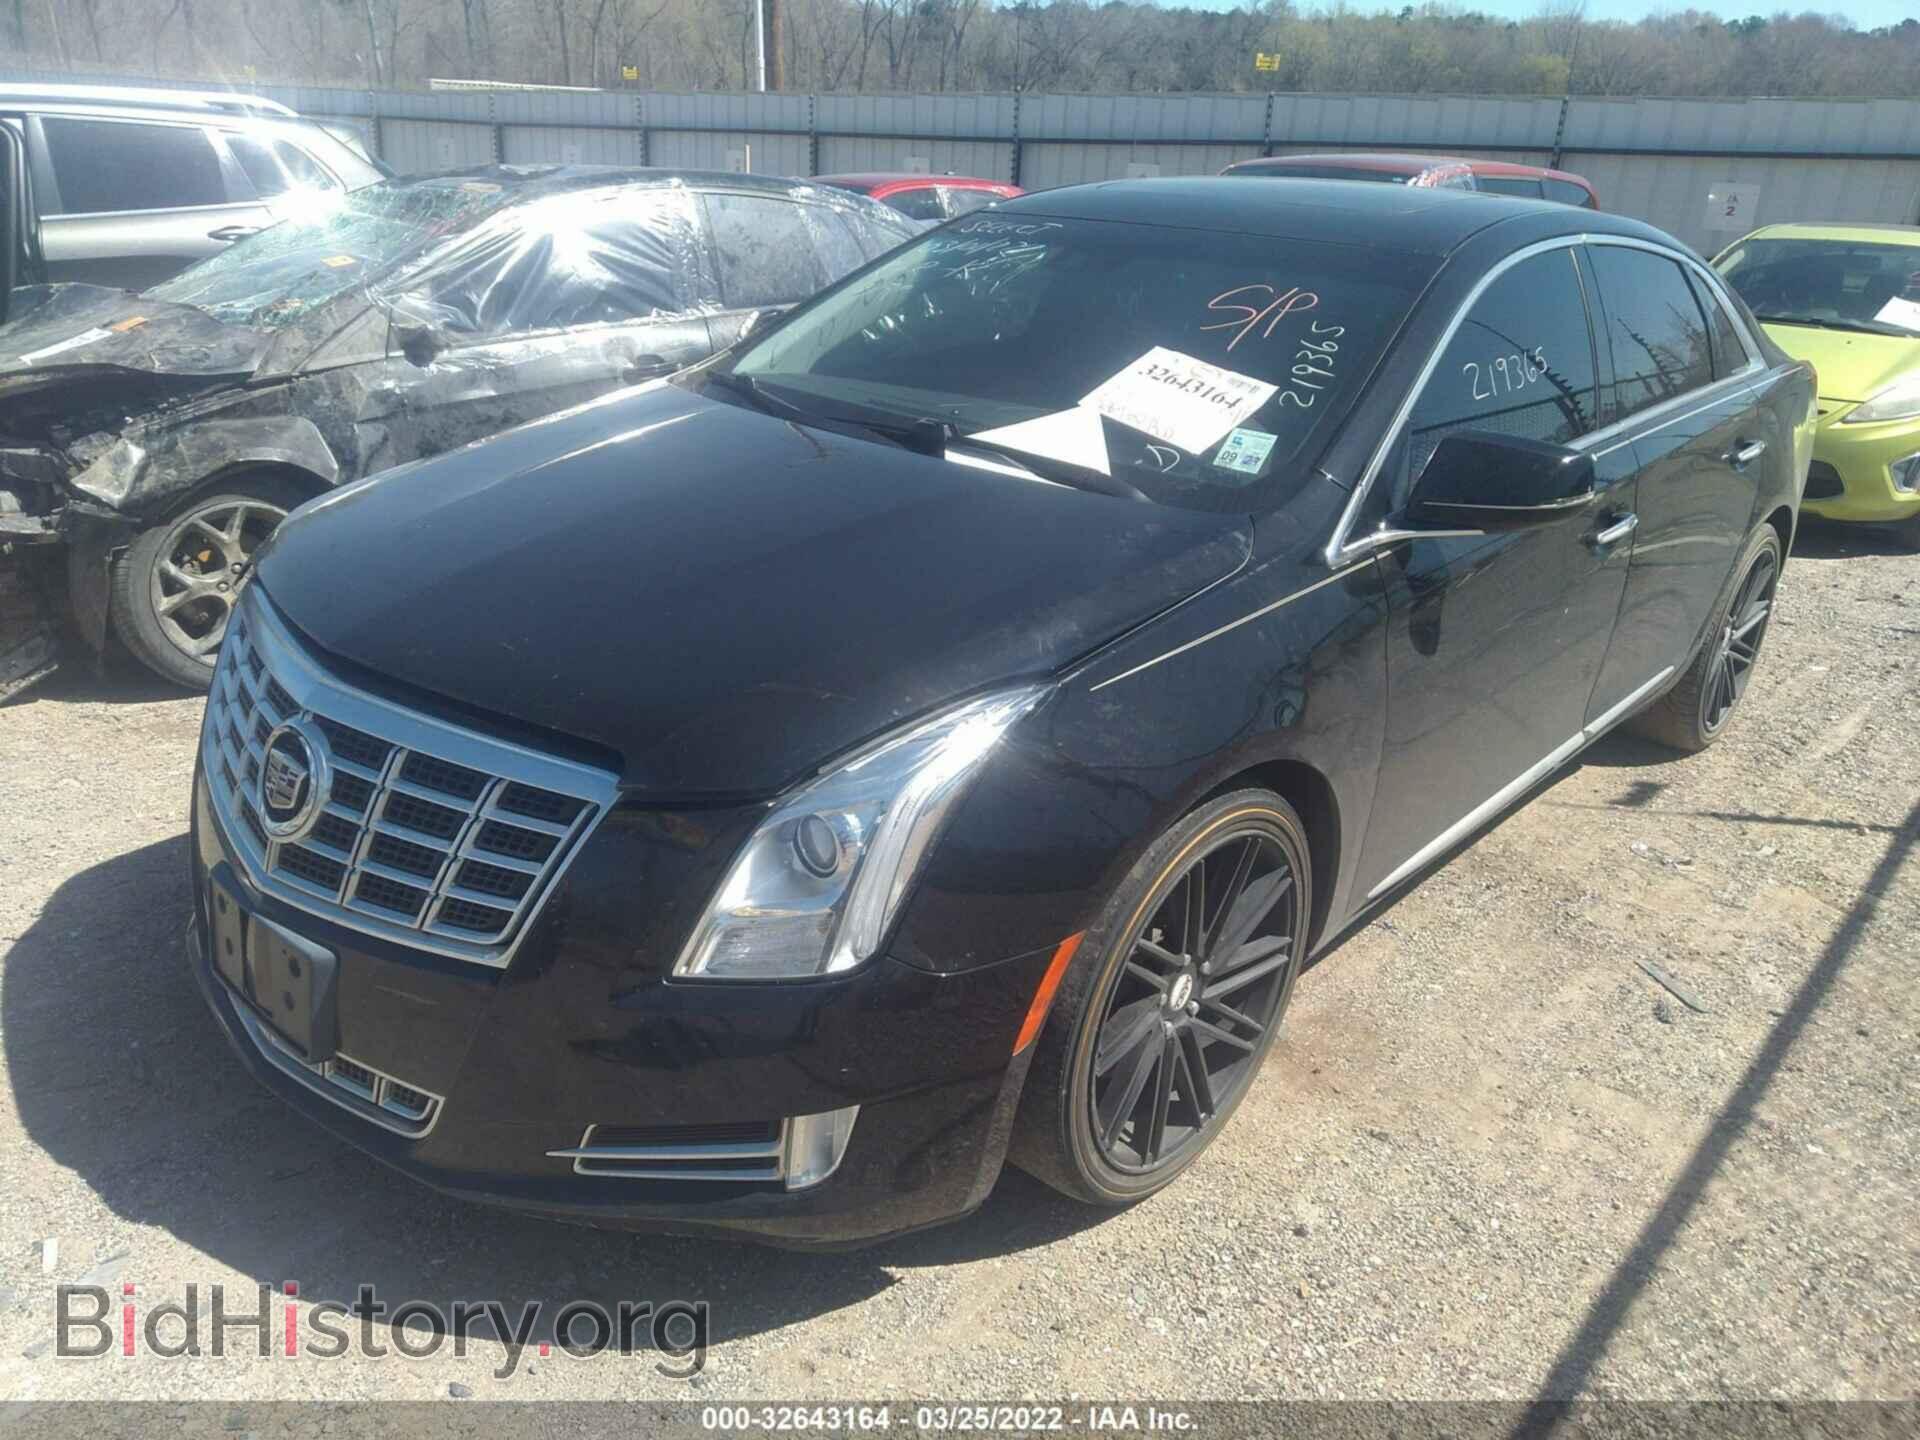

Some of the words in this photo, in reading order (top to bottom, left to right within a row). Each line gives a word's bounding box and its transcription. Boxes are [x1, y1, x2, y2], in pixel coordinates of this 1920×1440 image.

[1137, 363, 1244, 410] 32643164
[1278, 320, 1345, 408] 219365
[1462, 346, 1548, 400] 219365
